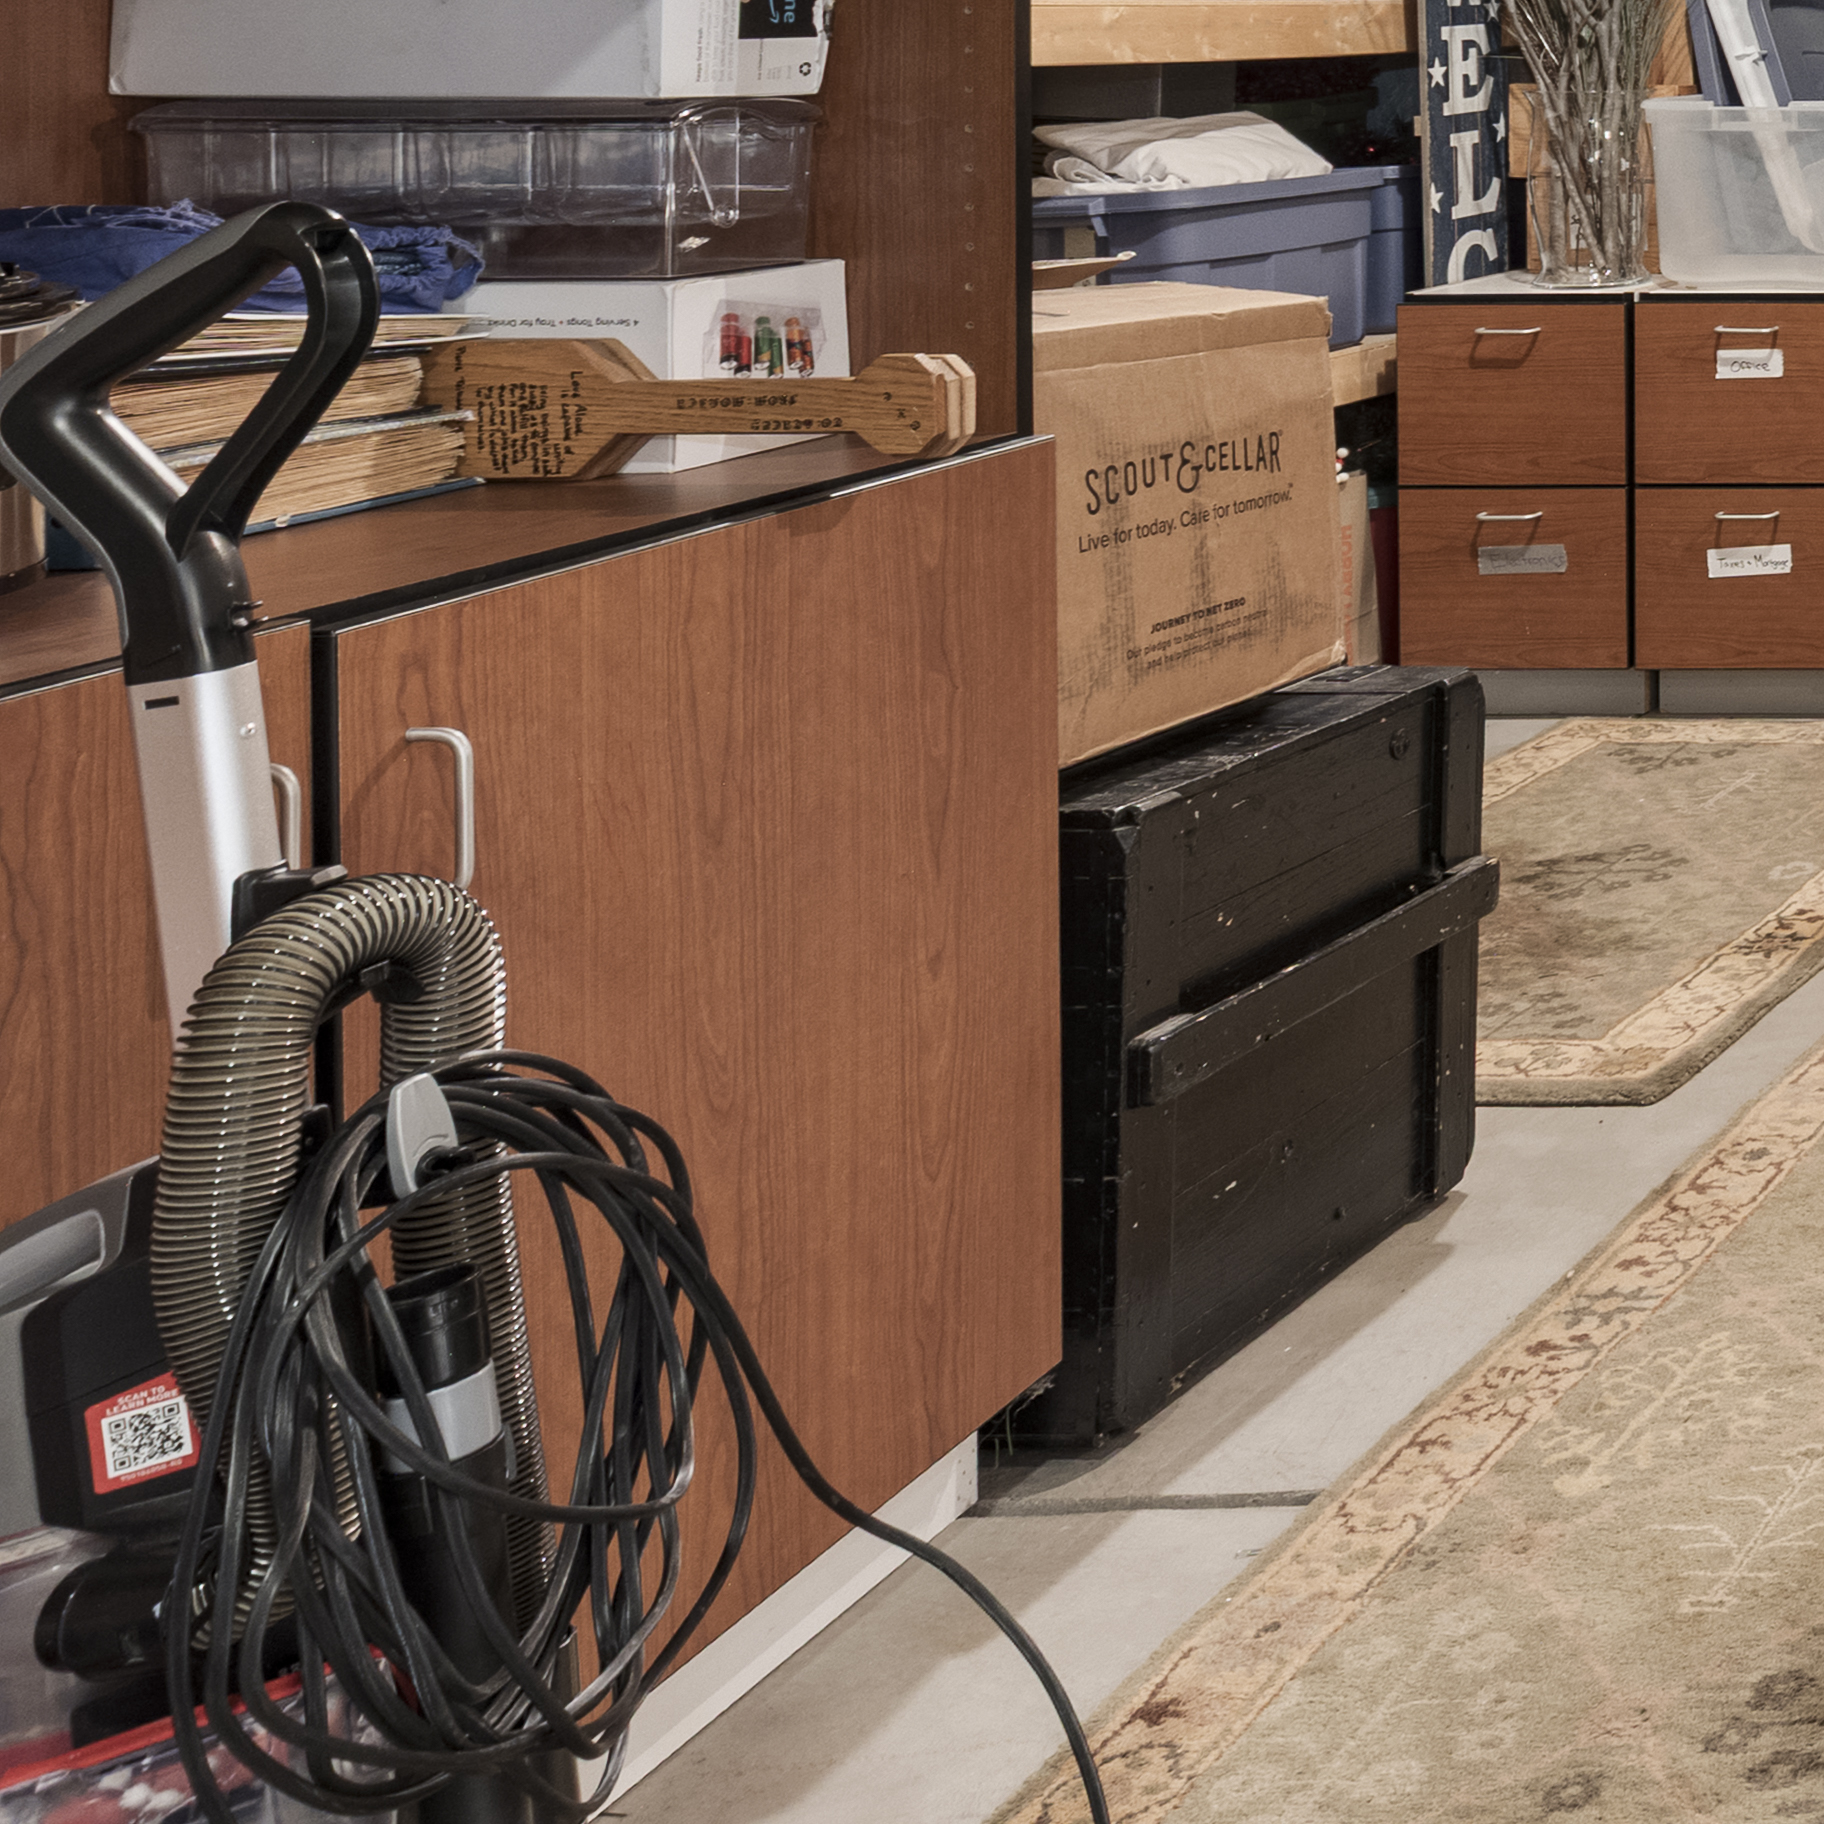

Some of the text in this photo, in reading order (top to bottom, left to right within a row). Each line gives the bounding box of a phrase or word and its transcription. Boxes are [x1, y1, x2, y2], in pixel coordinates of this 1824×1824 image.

[535, 318, 556, 328] Tray
[566, 318, 594, 328] Tongs
[596, 318, 631, 329] Serving
[1730, 359, 1772, 373] Office
[571, 370, 584, 399] Love
[1084, 430, 1282, 516] SCOUT & CELLAR
[1078, 489, 1293, 554] Live for today. Care for tomorrow.
[1150, 612, 1191, 634] JOURNEY
[1203, 604, 1222, 618] NET
[1222, 596, 1246, 612] ZERO
[105, 1387, 180, 1417] LEARN MORE
[116, 1384, 166, 1406] SCAN TO
